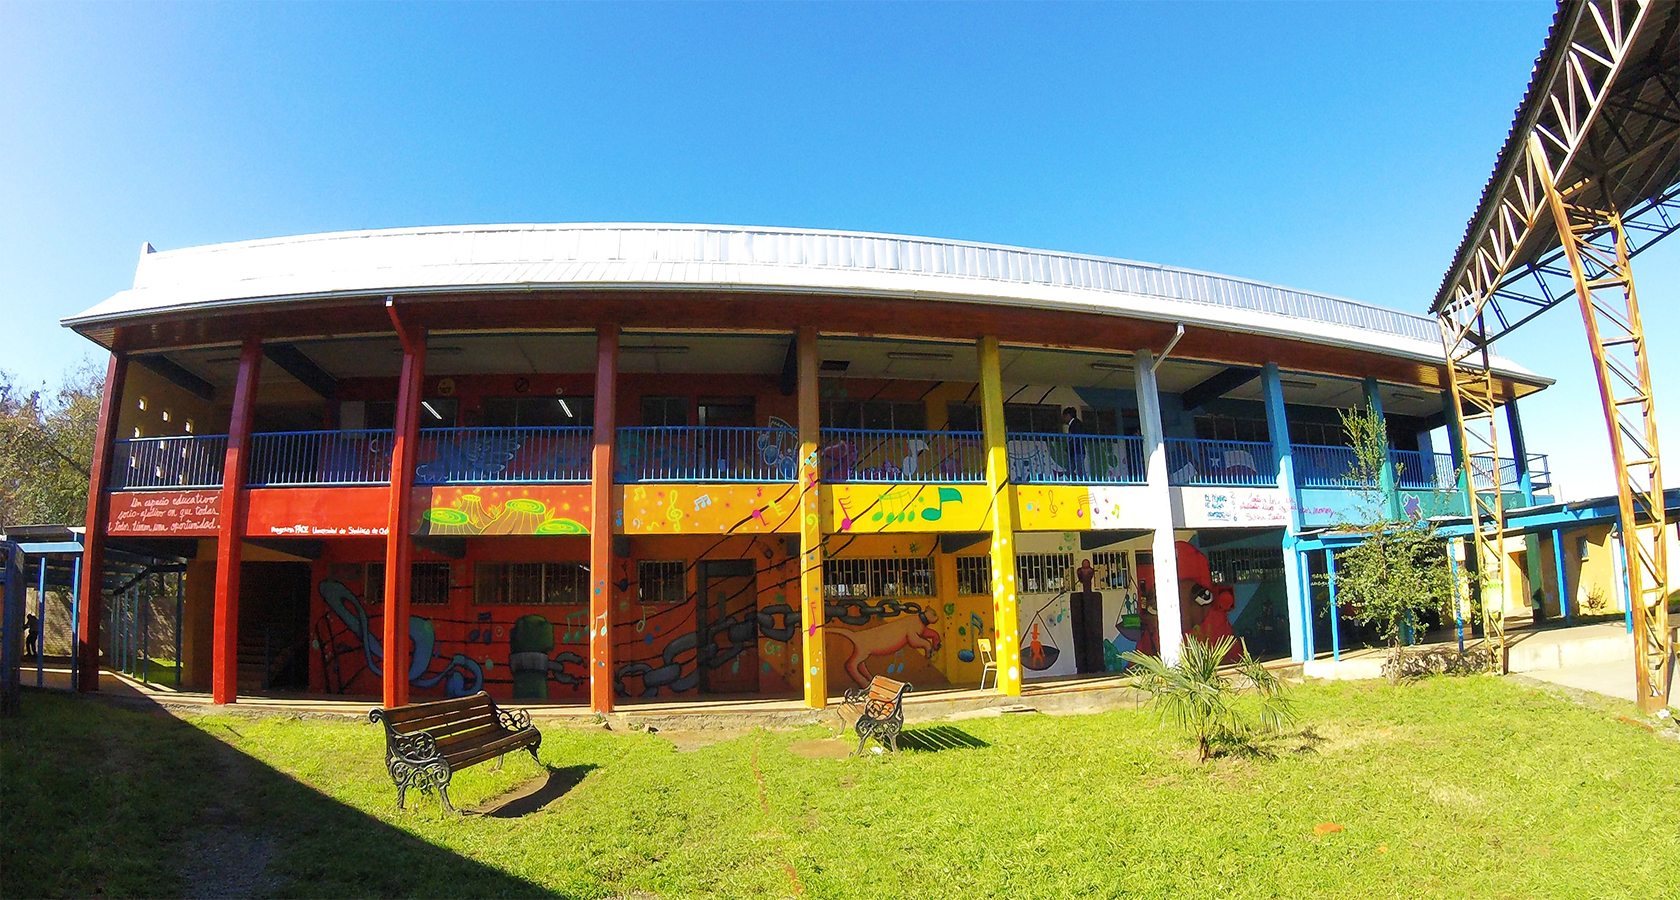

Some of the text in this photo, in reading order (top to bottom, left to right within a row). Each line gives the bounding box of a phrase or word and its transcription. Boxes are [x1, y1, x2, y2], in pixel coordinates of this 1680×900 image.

[131, 494, 218, 511] Un espacio educativo
[167, 508, 177, 517] en
[179, 508, 193, 521] que
[195, 504, 219, 516] todas
[132, 520, 152, 532] tienen
[152, 522, 169, 532] una
[294, 524, 309, 534] PACE
[348, 526, 371, 535] Santiago
[371, 526, 379, 534] de
